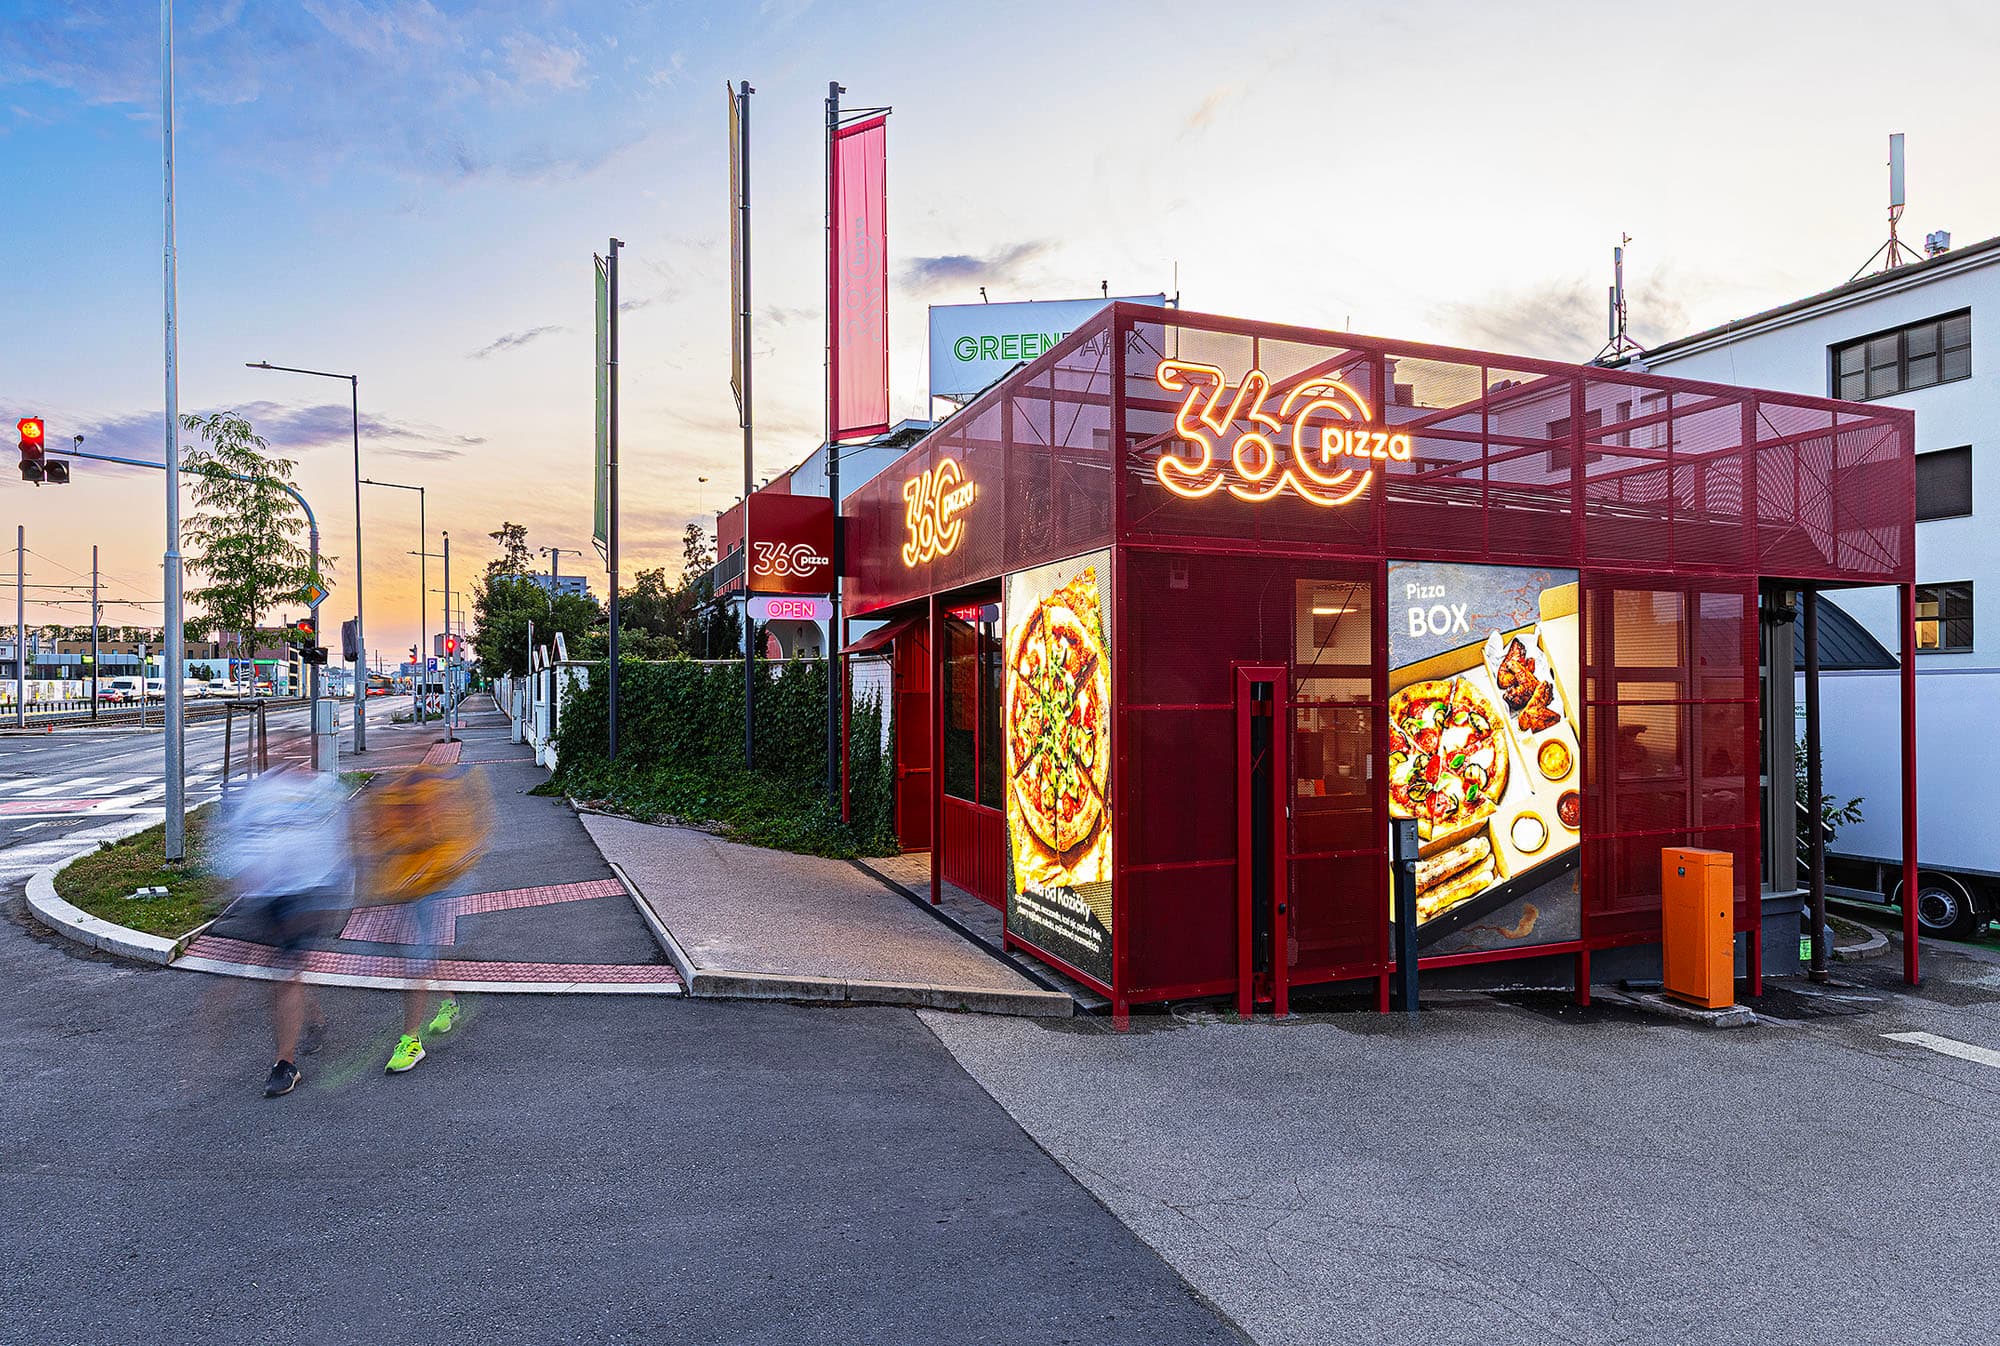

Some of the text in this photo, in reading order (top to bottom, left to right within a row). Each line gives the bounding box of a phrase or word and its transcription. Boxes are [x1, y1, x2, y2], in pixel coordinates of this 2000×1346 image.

[1156, 359, 1411, 507] 360 pizza
[942, 479, 976, 524] pizza
[753, 541, 829, 577] 360 pizza
[1406, 582, 1446, 600] Pizza
[767, 601, 815, 618] OPEN
[1408, 602, 1470, 638] BOX
[1044, 884, 1057, 903] od
[1057, 887, 1091, 923] Kozičky
